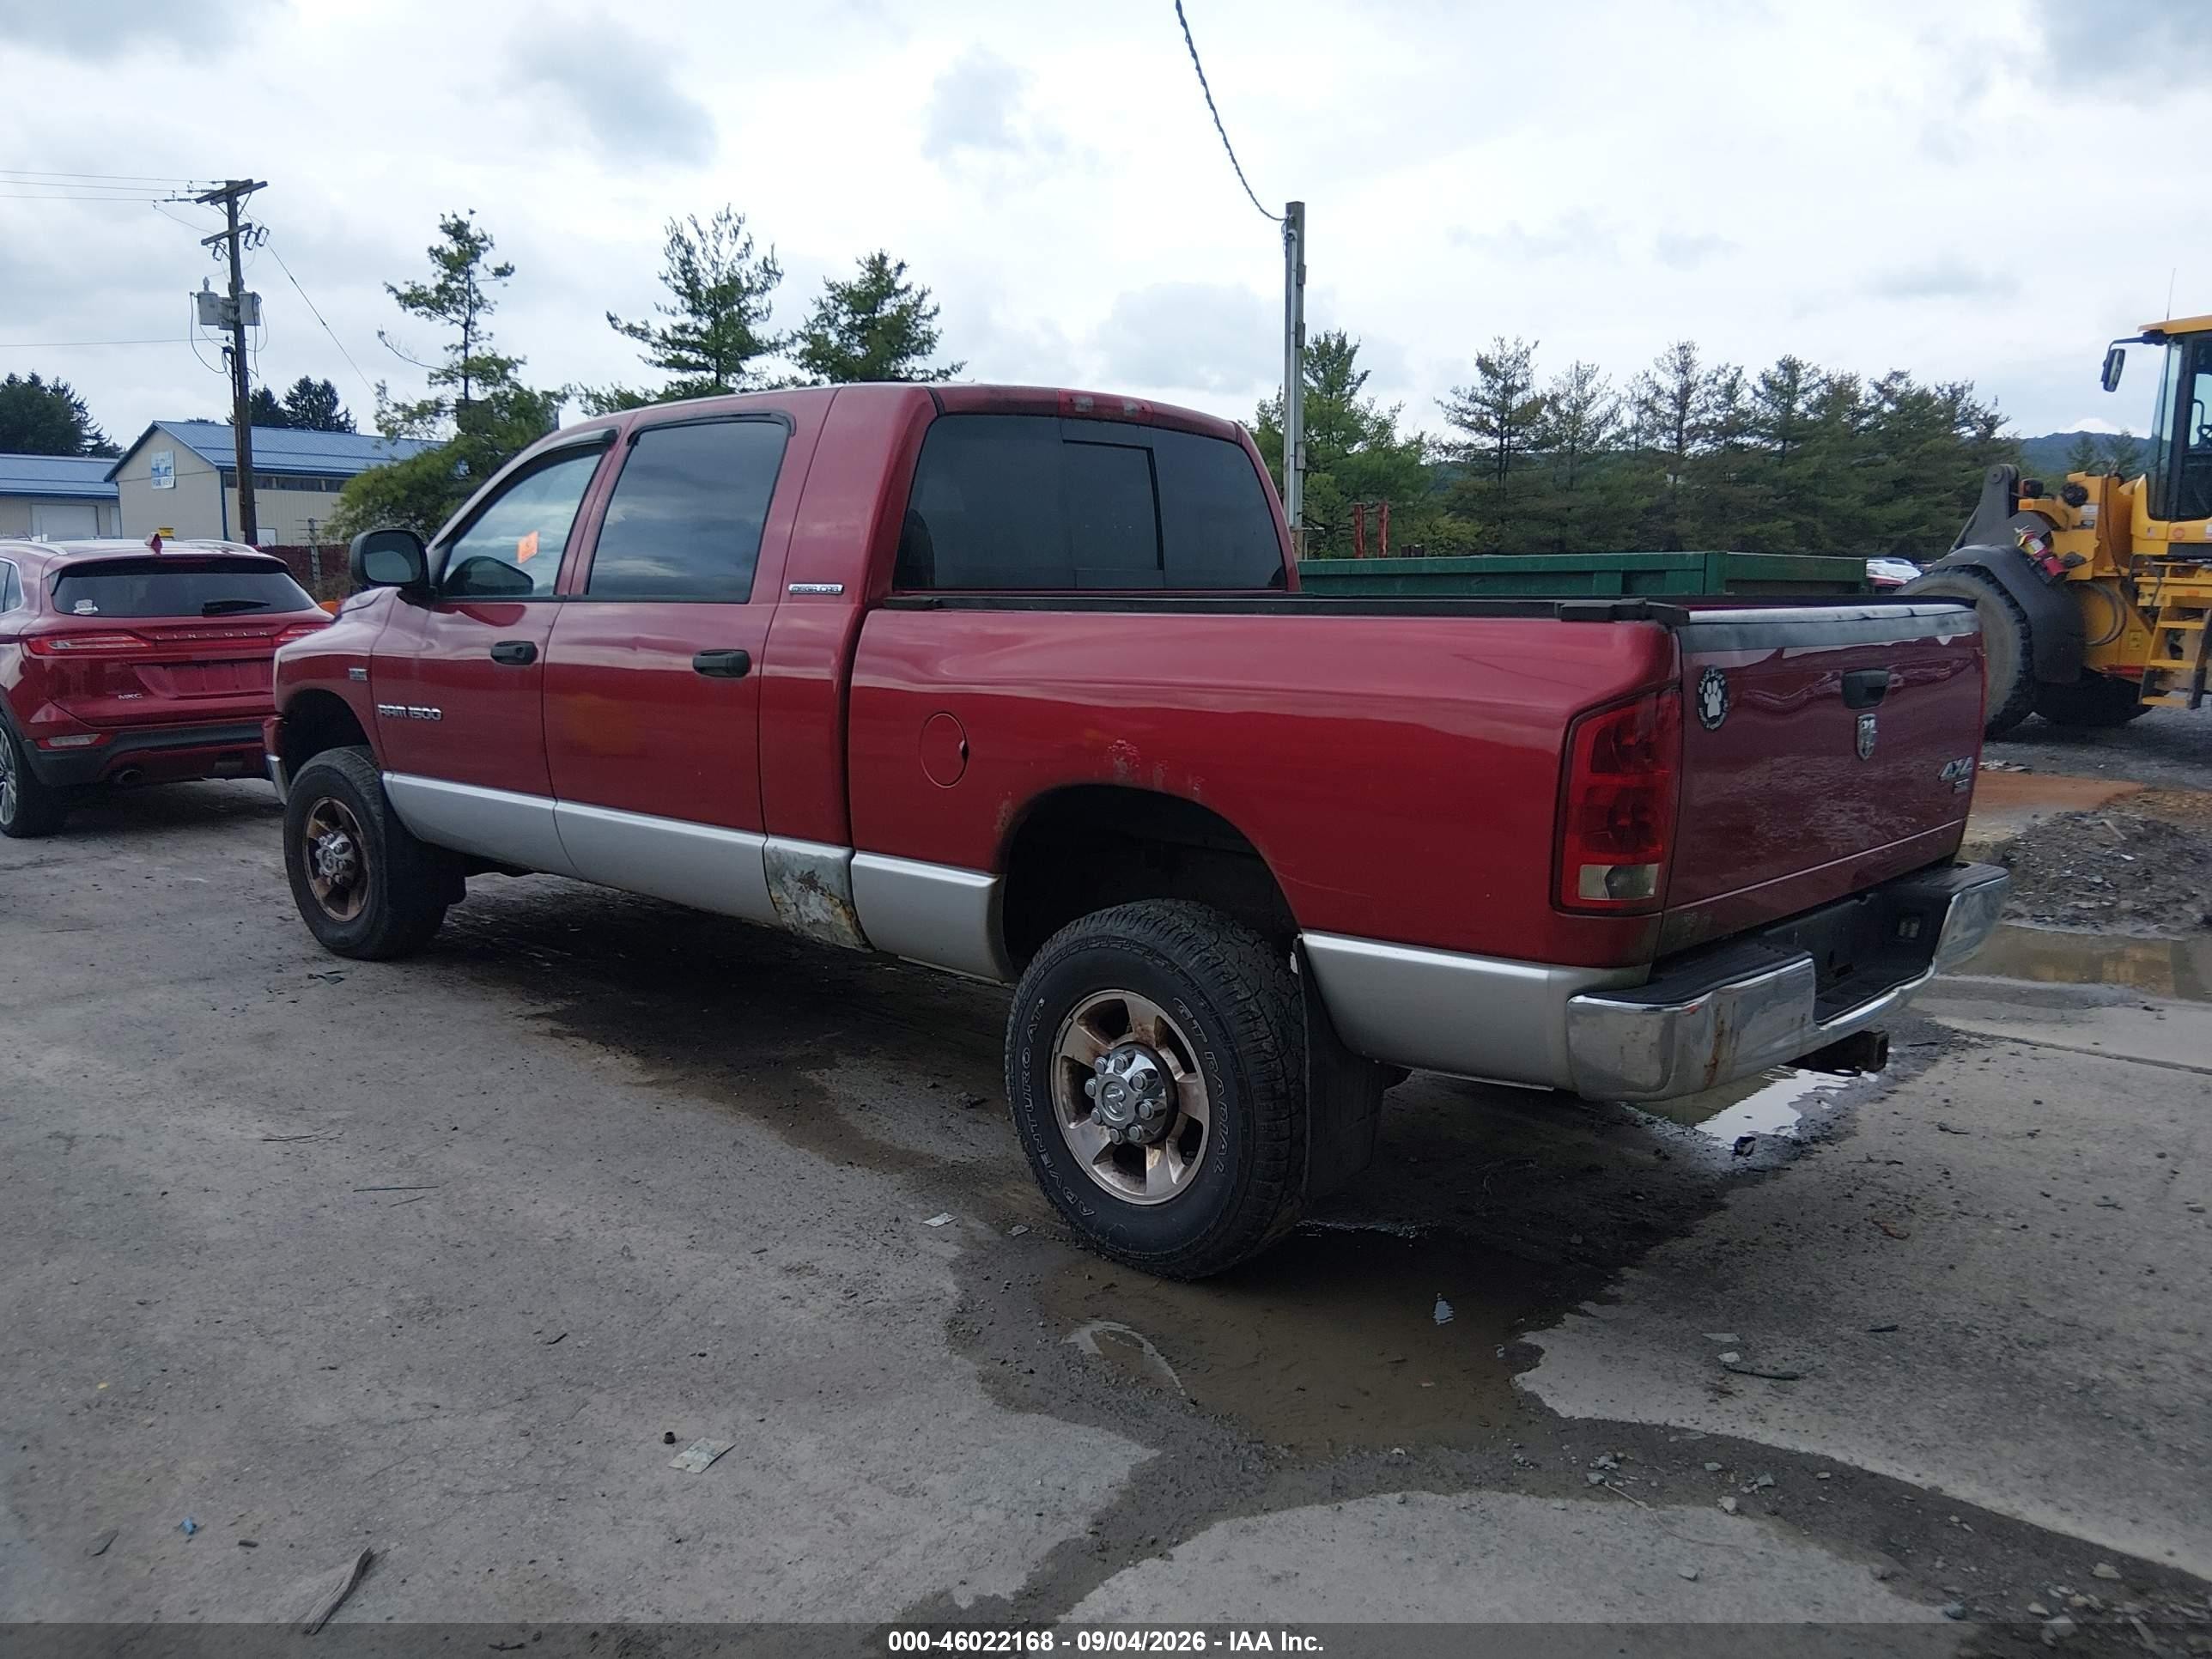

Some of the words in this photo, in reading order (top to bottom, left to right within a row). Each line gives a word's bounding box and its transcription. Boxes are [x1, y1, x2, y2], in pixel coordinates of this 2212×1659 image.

[156, 630, 270, 641] LINCOLN
[378, 703, 407, 718] RAM
[1021, 1046, 1095, 1216] ADVENTURO
[1173, 997, 1207, 1043] GT
[1204, 1051, 1230, 1174] RADIAL
